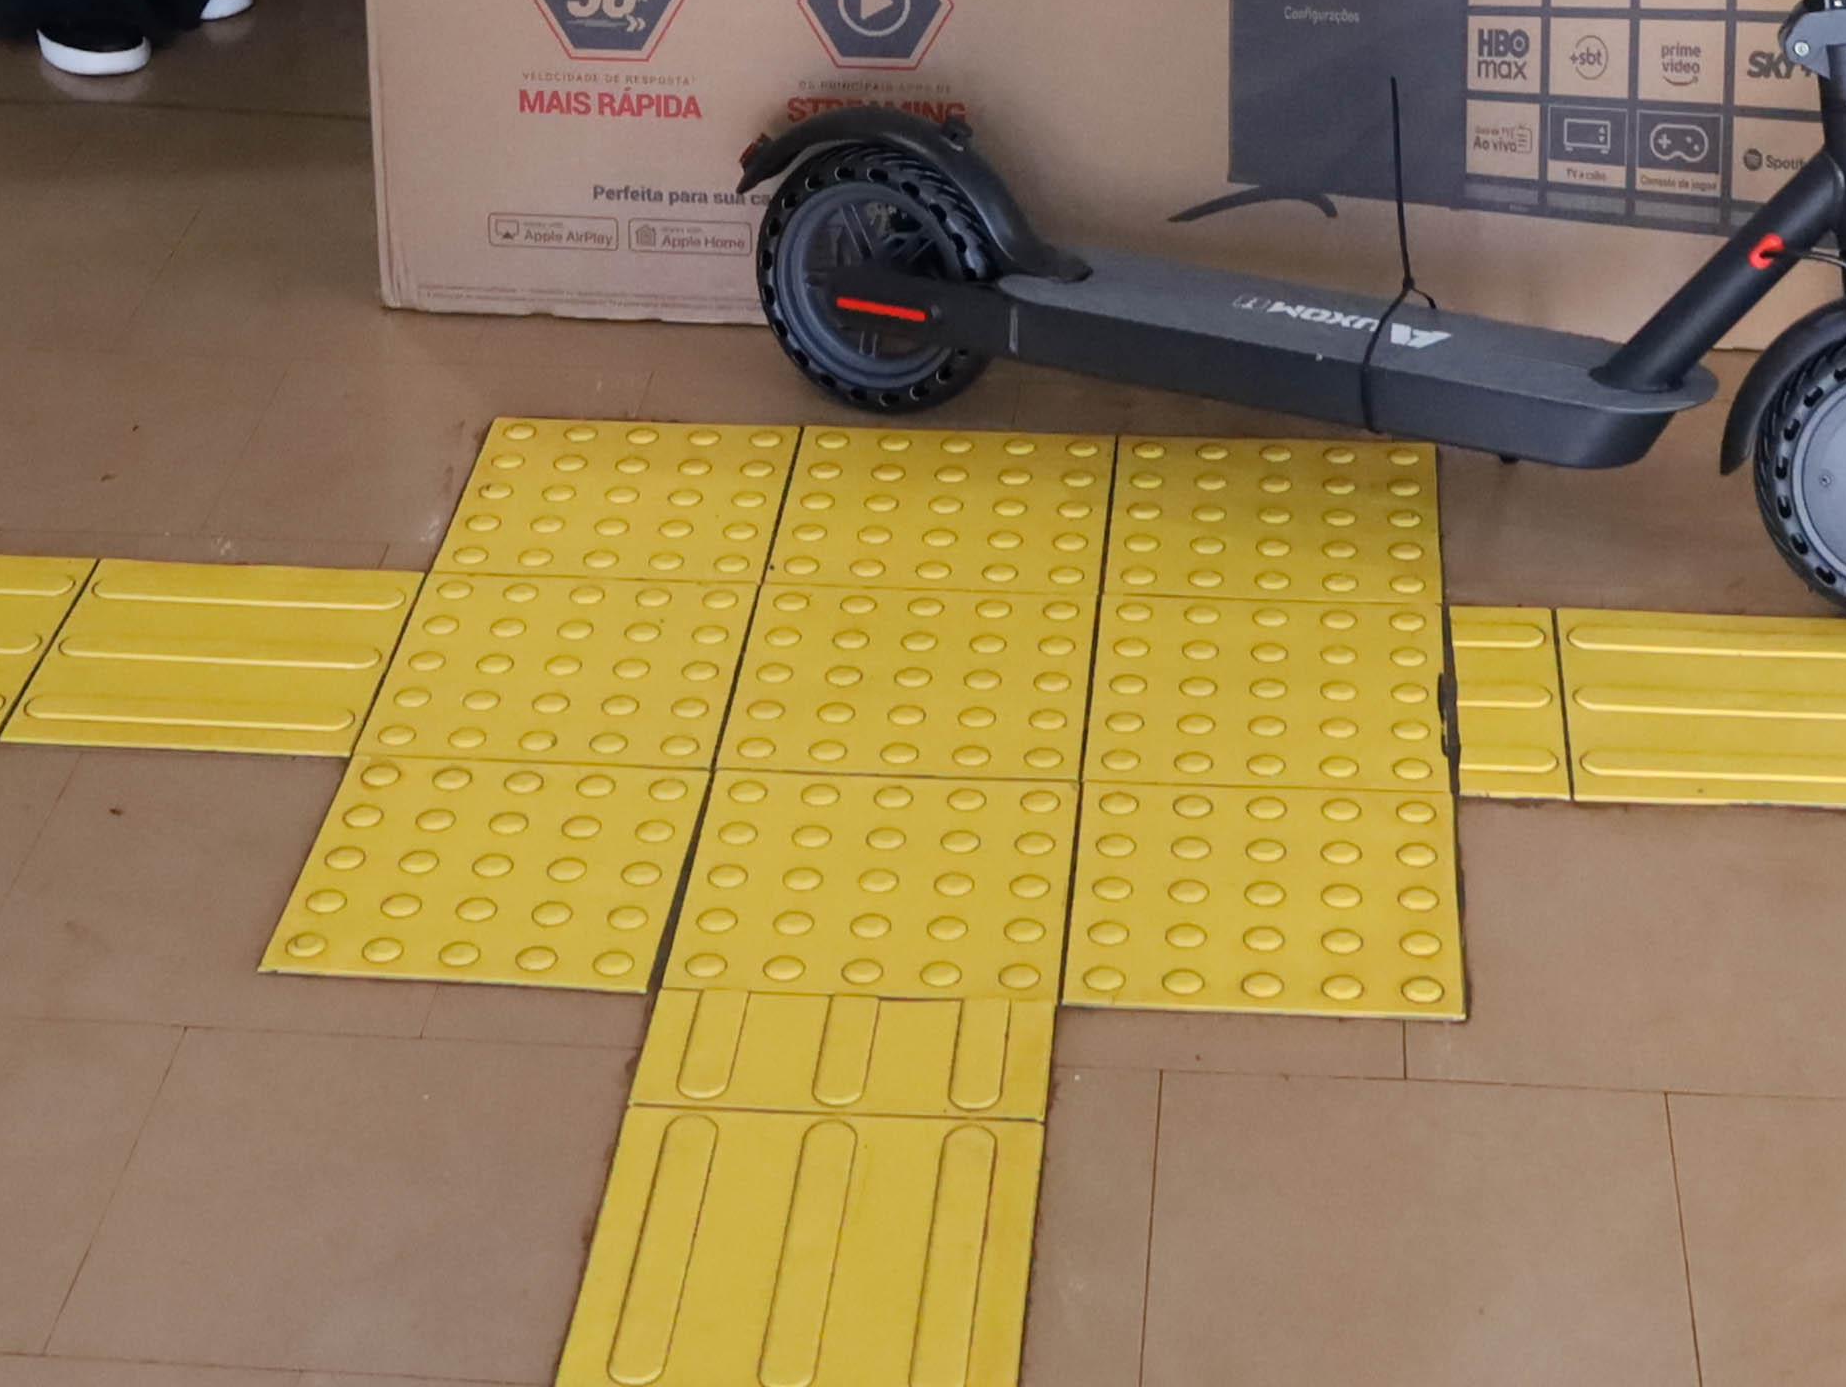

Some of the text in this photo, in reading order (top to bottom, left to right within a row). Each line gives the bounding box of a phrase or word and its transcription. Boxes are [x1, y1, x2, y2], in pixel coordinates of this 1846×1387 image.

[1477, 28, 1529, 58] HBO
[1661, 42, 1702, 61] prime
[1477, 58, 1528, 80] max
[1662, 57, 1701, 75] video
[522, 72, 597, 84] VELOCIDADE
[605, 73, 619, 84] DE
[519, 86, 703, 119] MAIS RÁPIDA
[1473, 136, 1517, 153] Ao vivo
[592, 184, 663, 204] Perfeita
[668, 189, 708, 206] para
[713, 191, 746, 206] sua
[524, 230, 613, 246] Apple AirPlay
[662, 235, 745, 250] Apple Home
